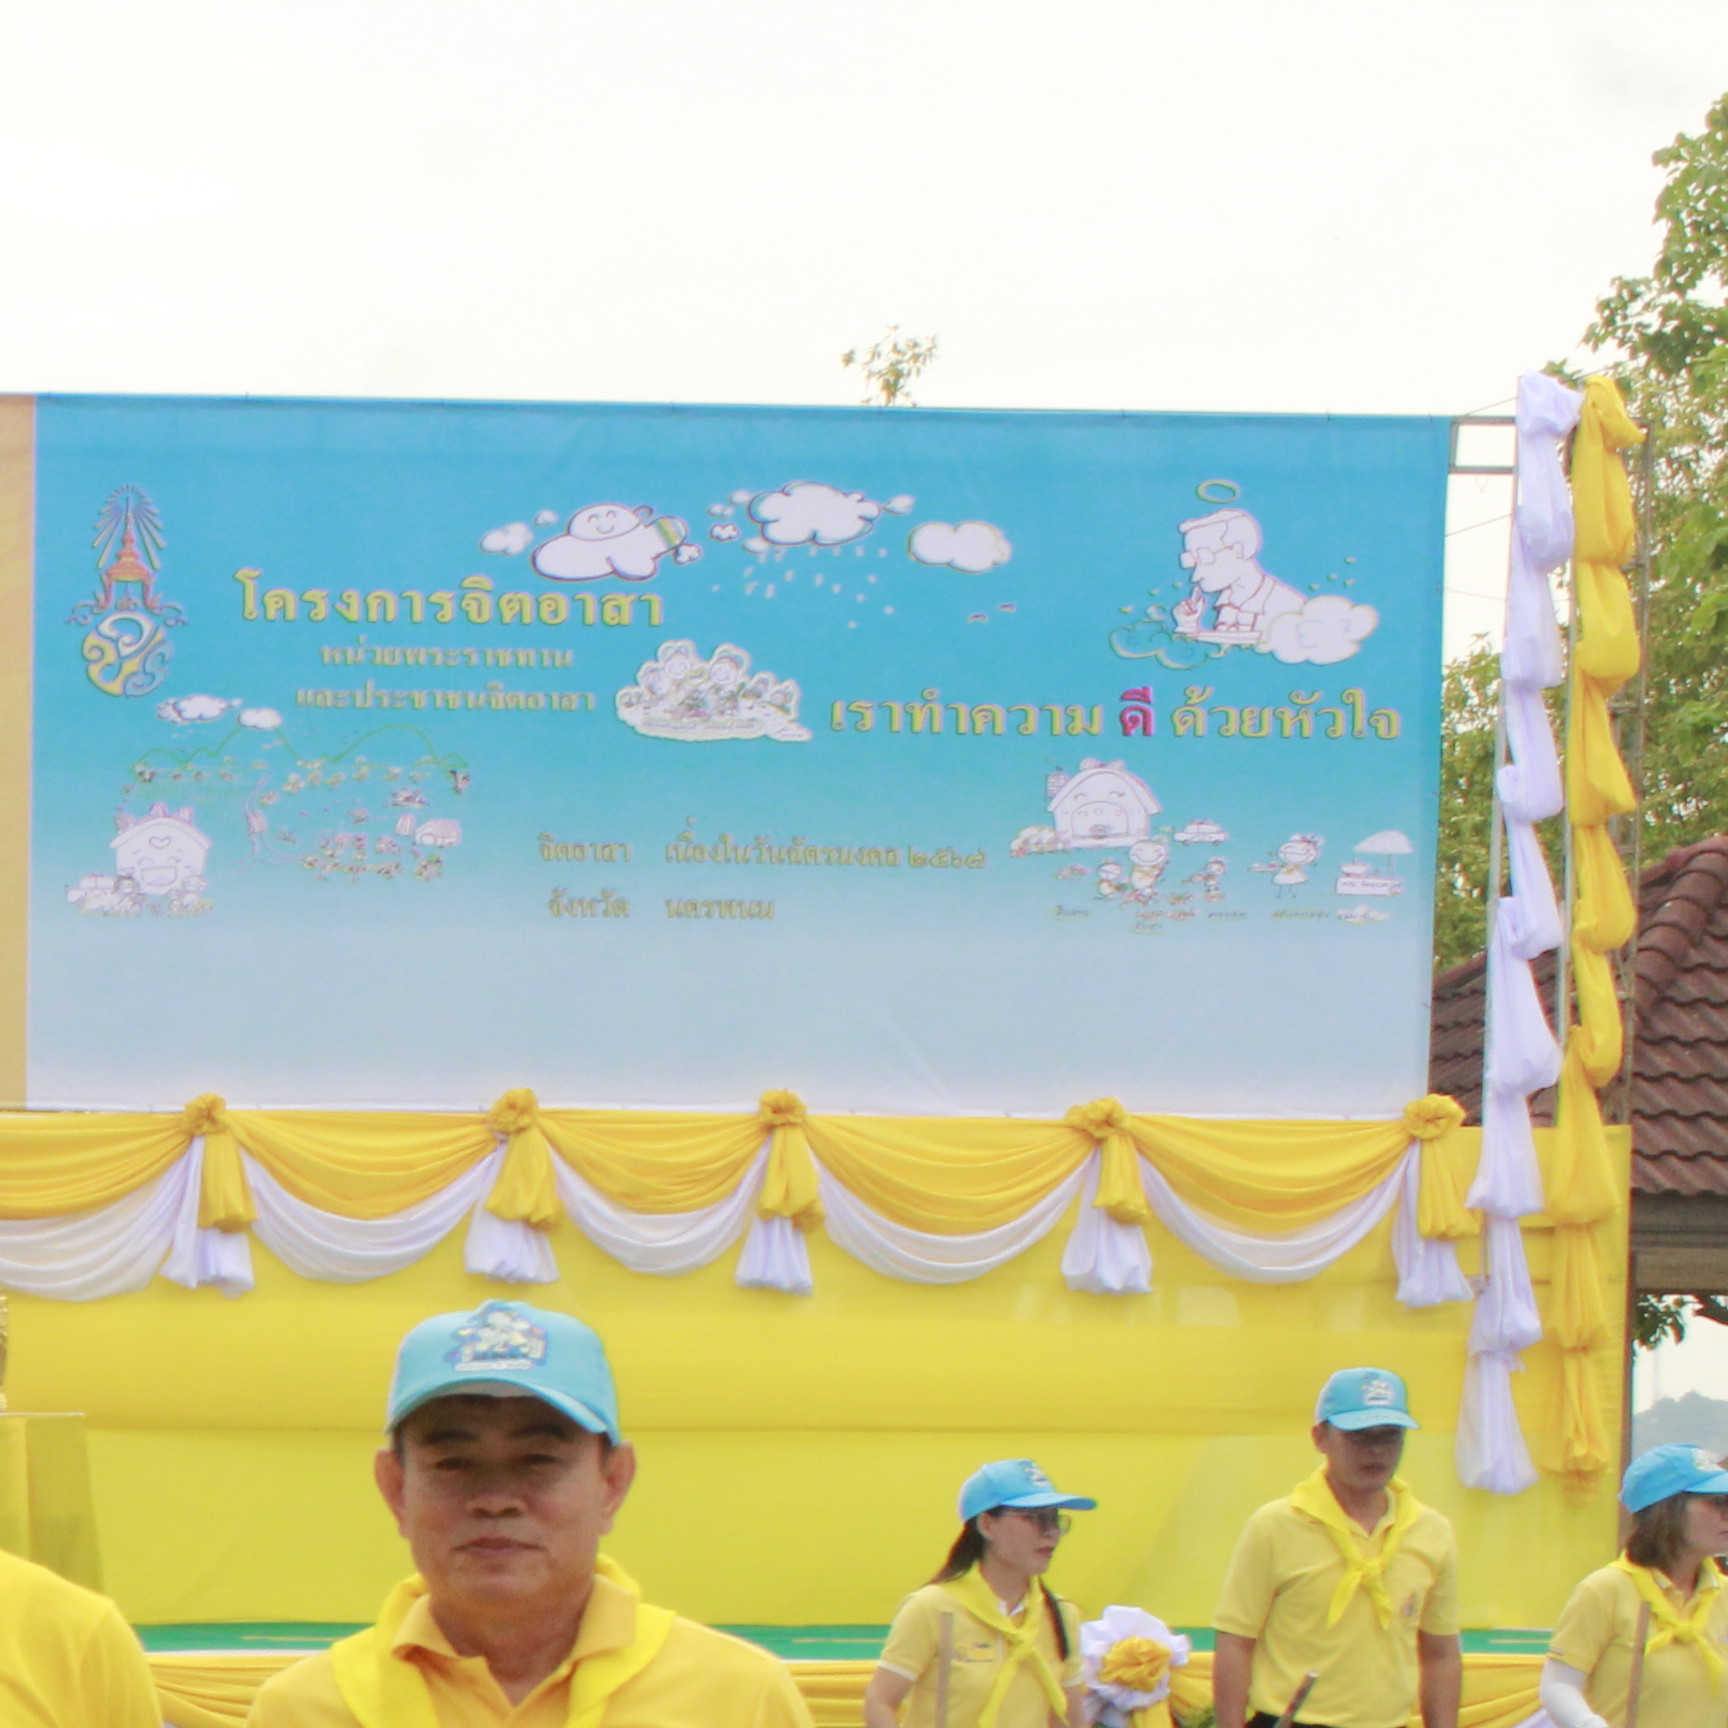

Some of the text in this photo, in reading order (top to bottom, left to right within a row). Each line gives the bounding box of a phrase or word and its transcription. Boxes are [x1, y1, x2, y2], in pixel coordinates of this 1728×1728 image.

[233, 568, 663, 626] โครงการจิตอาสา
[319, 635, 573, 668] หน่วยพระราชทาน
[295, 679, 595, 712] และประชาชนจิตอาสา
[830, 685, 1401, 740] เราทำความ ดี ด้วยหัวใจ
[538, 831, 632, 863] จิตอาสา
[547, 887, 775, 920] จังหวัด นครพนม
